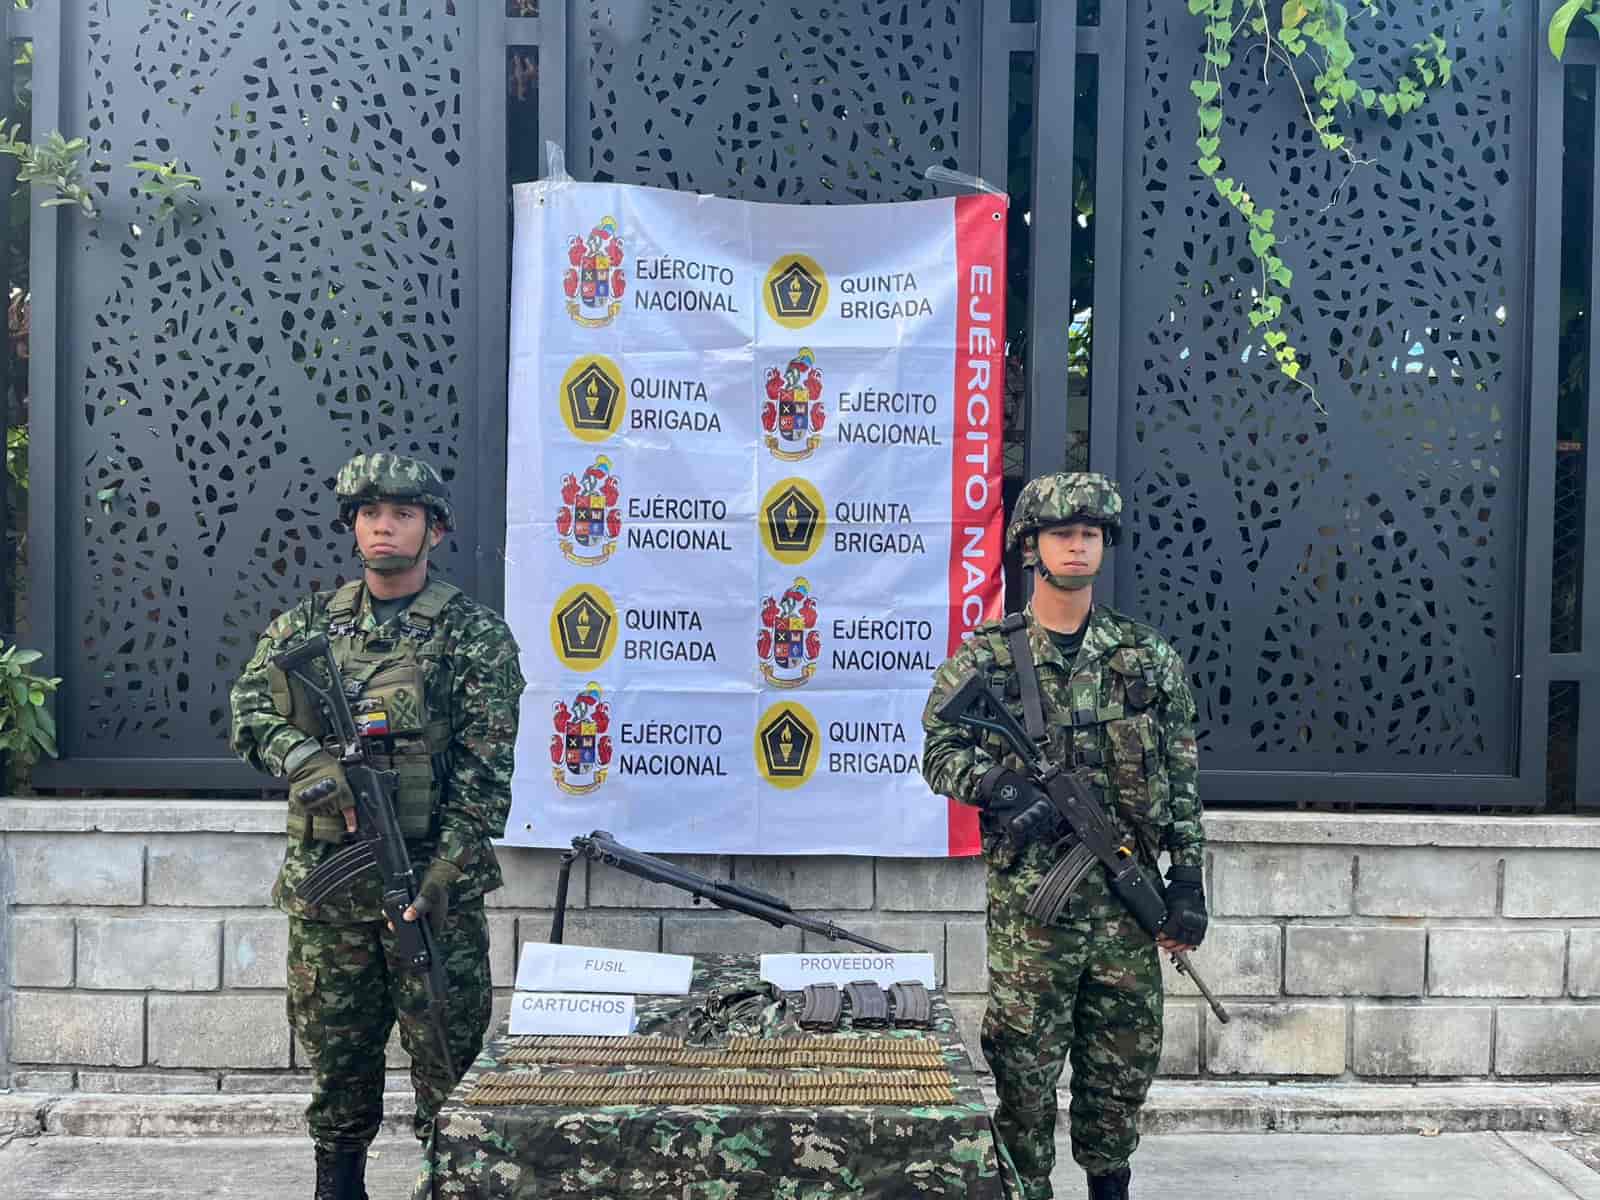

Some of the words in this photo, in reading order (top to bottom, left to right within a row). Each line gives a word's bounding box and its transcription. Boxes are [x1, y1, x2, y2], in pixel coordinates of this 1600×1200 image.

[637, 255, 733, 285] EJÉRCITO
[840, 273, 916, 294] QUINTA
[636, 290, 738, 312] NACIONAL
[841, 298, 932, 319] BRIGADA
[631, 378, 707, 402] QUINTA
[965, 265, 995, 511] EJÉRCITO
[840, 388, 936, 414] EJÉRCITO
[631, 409, 721, 432] BRIGADA
[839, 423, 941, 445] NACIONAL
[629, 494, 726, 520] EJÉRCITO
[836, 502, 911, 525] QUINTA
[628, 528, 732, 550] NACIONAL
[835, 532, 925, 553] BRIGADA
[626, 609, 702, 631] QUINTA
[833, 616, 932, 640] EJÉRCITO
[624, 640, 716, 662] BRIGADA
[833, 650, 936, 671] NACIONAL
[621, 720, 721, 745] EJÉRCITO
[830, 722, 905, 743] QUINTA
[620, 755, 727, 776] NACIONAL
[829, 752, 921, 774] BRIGADA
[585, 959, 626, 974] FUSIL
[801, 957, 894, 971] PROVEEDOR
[522, 997, 626, 1015] CARTUCHOS
